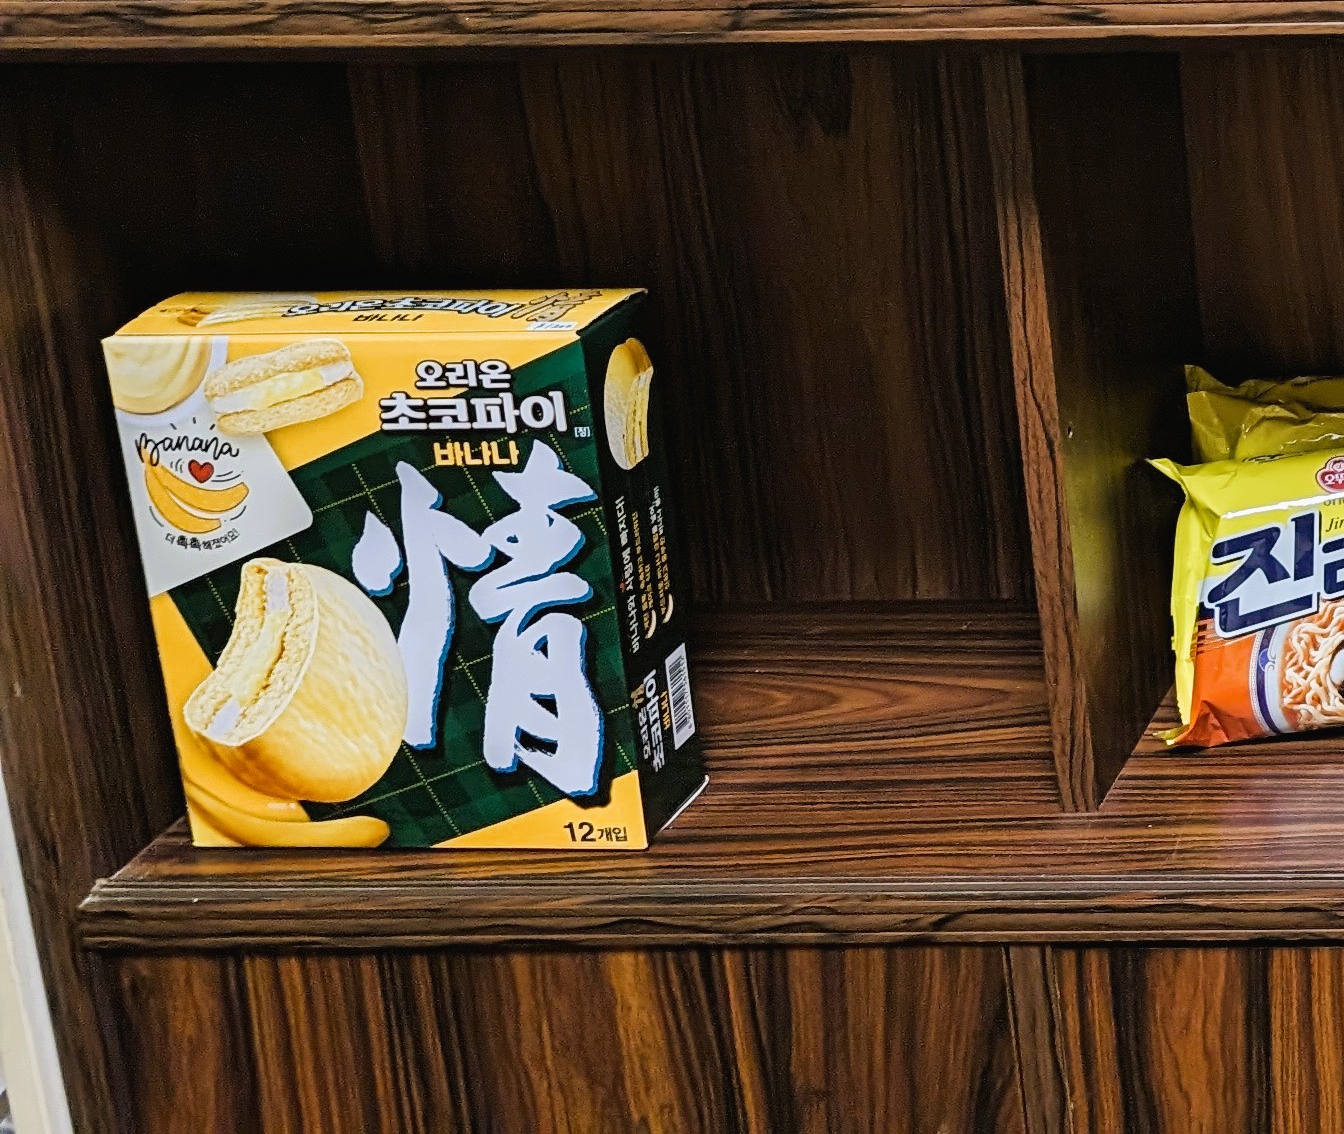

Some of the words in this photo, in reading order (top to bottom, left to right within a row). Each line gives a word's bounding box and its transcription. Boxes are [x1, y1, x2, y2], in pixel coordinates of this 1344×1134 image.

[415, 360, 512, 389] 오리온
[380, 391, 568, 434] 초코파이
[135, 432, 240, 467] Banana
[433, 441, 520, 466] 바나나
[352, 438, 605, 796] 情
[625, 594, 639, 654] 바나나와
[643, 669, 666, 772] 초코파이
[660, 690, 671, 730] 바나나
[638, 706, 652, 760] 오리온
[562, 821, 629, 844] 12개입
